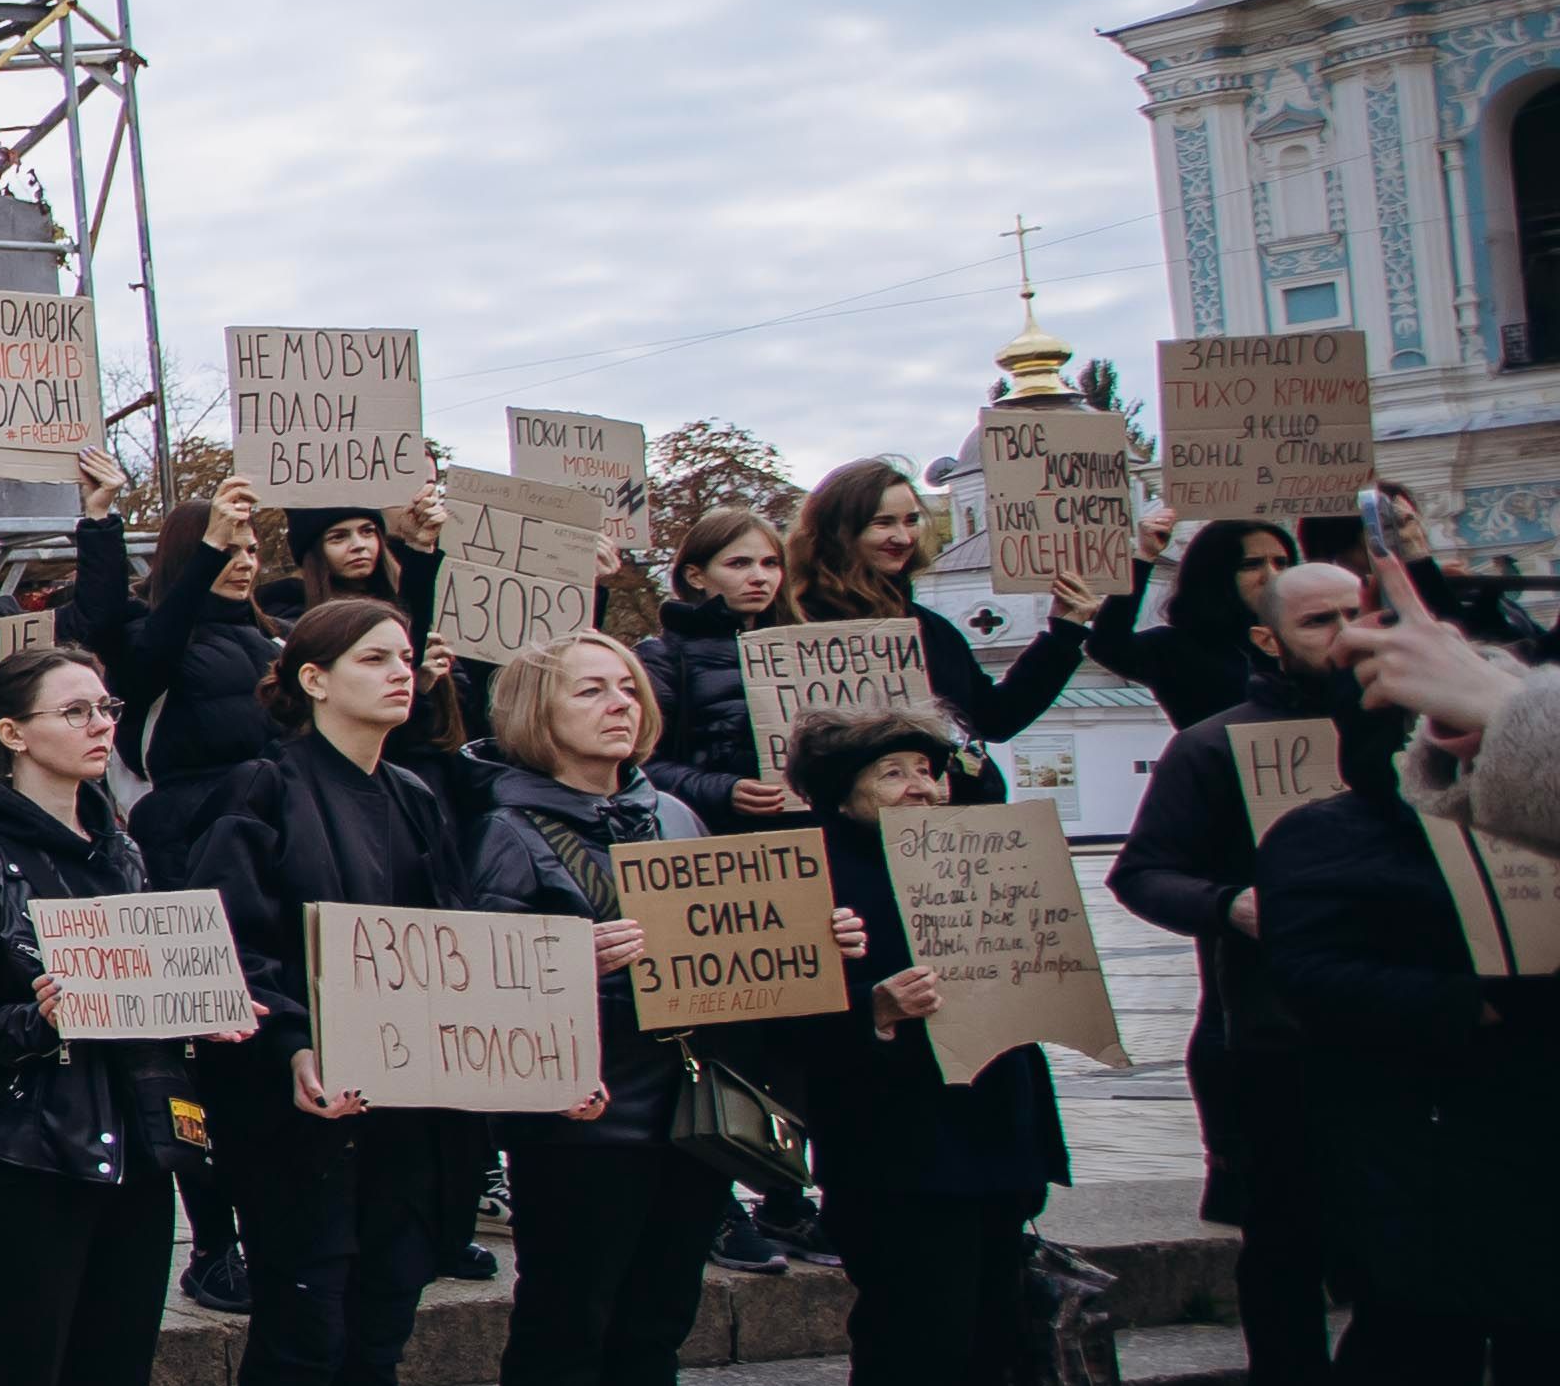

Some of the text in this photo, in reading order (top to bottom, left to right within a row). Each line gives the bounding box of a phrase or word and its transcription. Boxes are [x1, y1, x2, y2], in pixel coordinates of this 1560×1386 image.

[238, 334, 272, 380] НЕ
[1182, 335, 1337, 370] ЗАНАДТО
[1164, 378, 1368, 408] ТИХО КРИЧИМО
[237, 391, 357, 435] ПОЛОН
[1236, 414, 1318, 439] ЯКЩО
[6, 423, 91, 444] #FREEAZOV
[516, 417, 603, 452] ПОКИ ТИ
[986, 423, 1048, 461] ТВОЄ
[269, 433, 415, 485] ВБИВАЄ
[1171, 440, 1366, 467] ВОНИ СТІЛЬКИ
[1171, 481, 1239, 504] ПЕКЛІ
[1257, 467, 1273, 484] В
[462, 504, 542, 577] ДЕ
[1001, 525, 1129, 580] ОЛЕНІВКА
[745, 643, 788, 678] НЕ
[900, 819, 1028, 858] Життя
[620, 844, 819, 893] ПОВЕРНІТЬ
[40, 904, 219, 940] ШАНУЙ ПОЛЕГЛИХ
[686, 900, 784, 936] СИНА
[49, 945, 232, 980] ДОПОМАГАЙ ЖИВИМ
[353, 917, 564, 1001] АЗОВ ЩЕ
[637, 945, 819, 993] З ПОЛОНУ
[58, 990, 248, 1028] КРИЧИ ПРО ПОЛОНЕНИХ
[380, 1018, 578, 1085] В ПОЛОНІ
